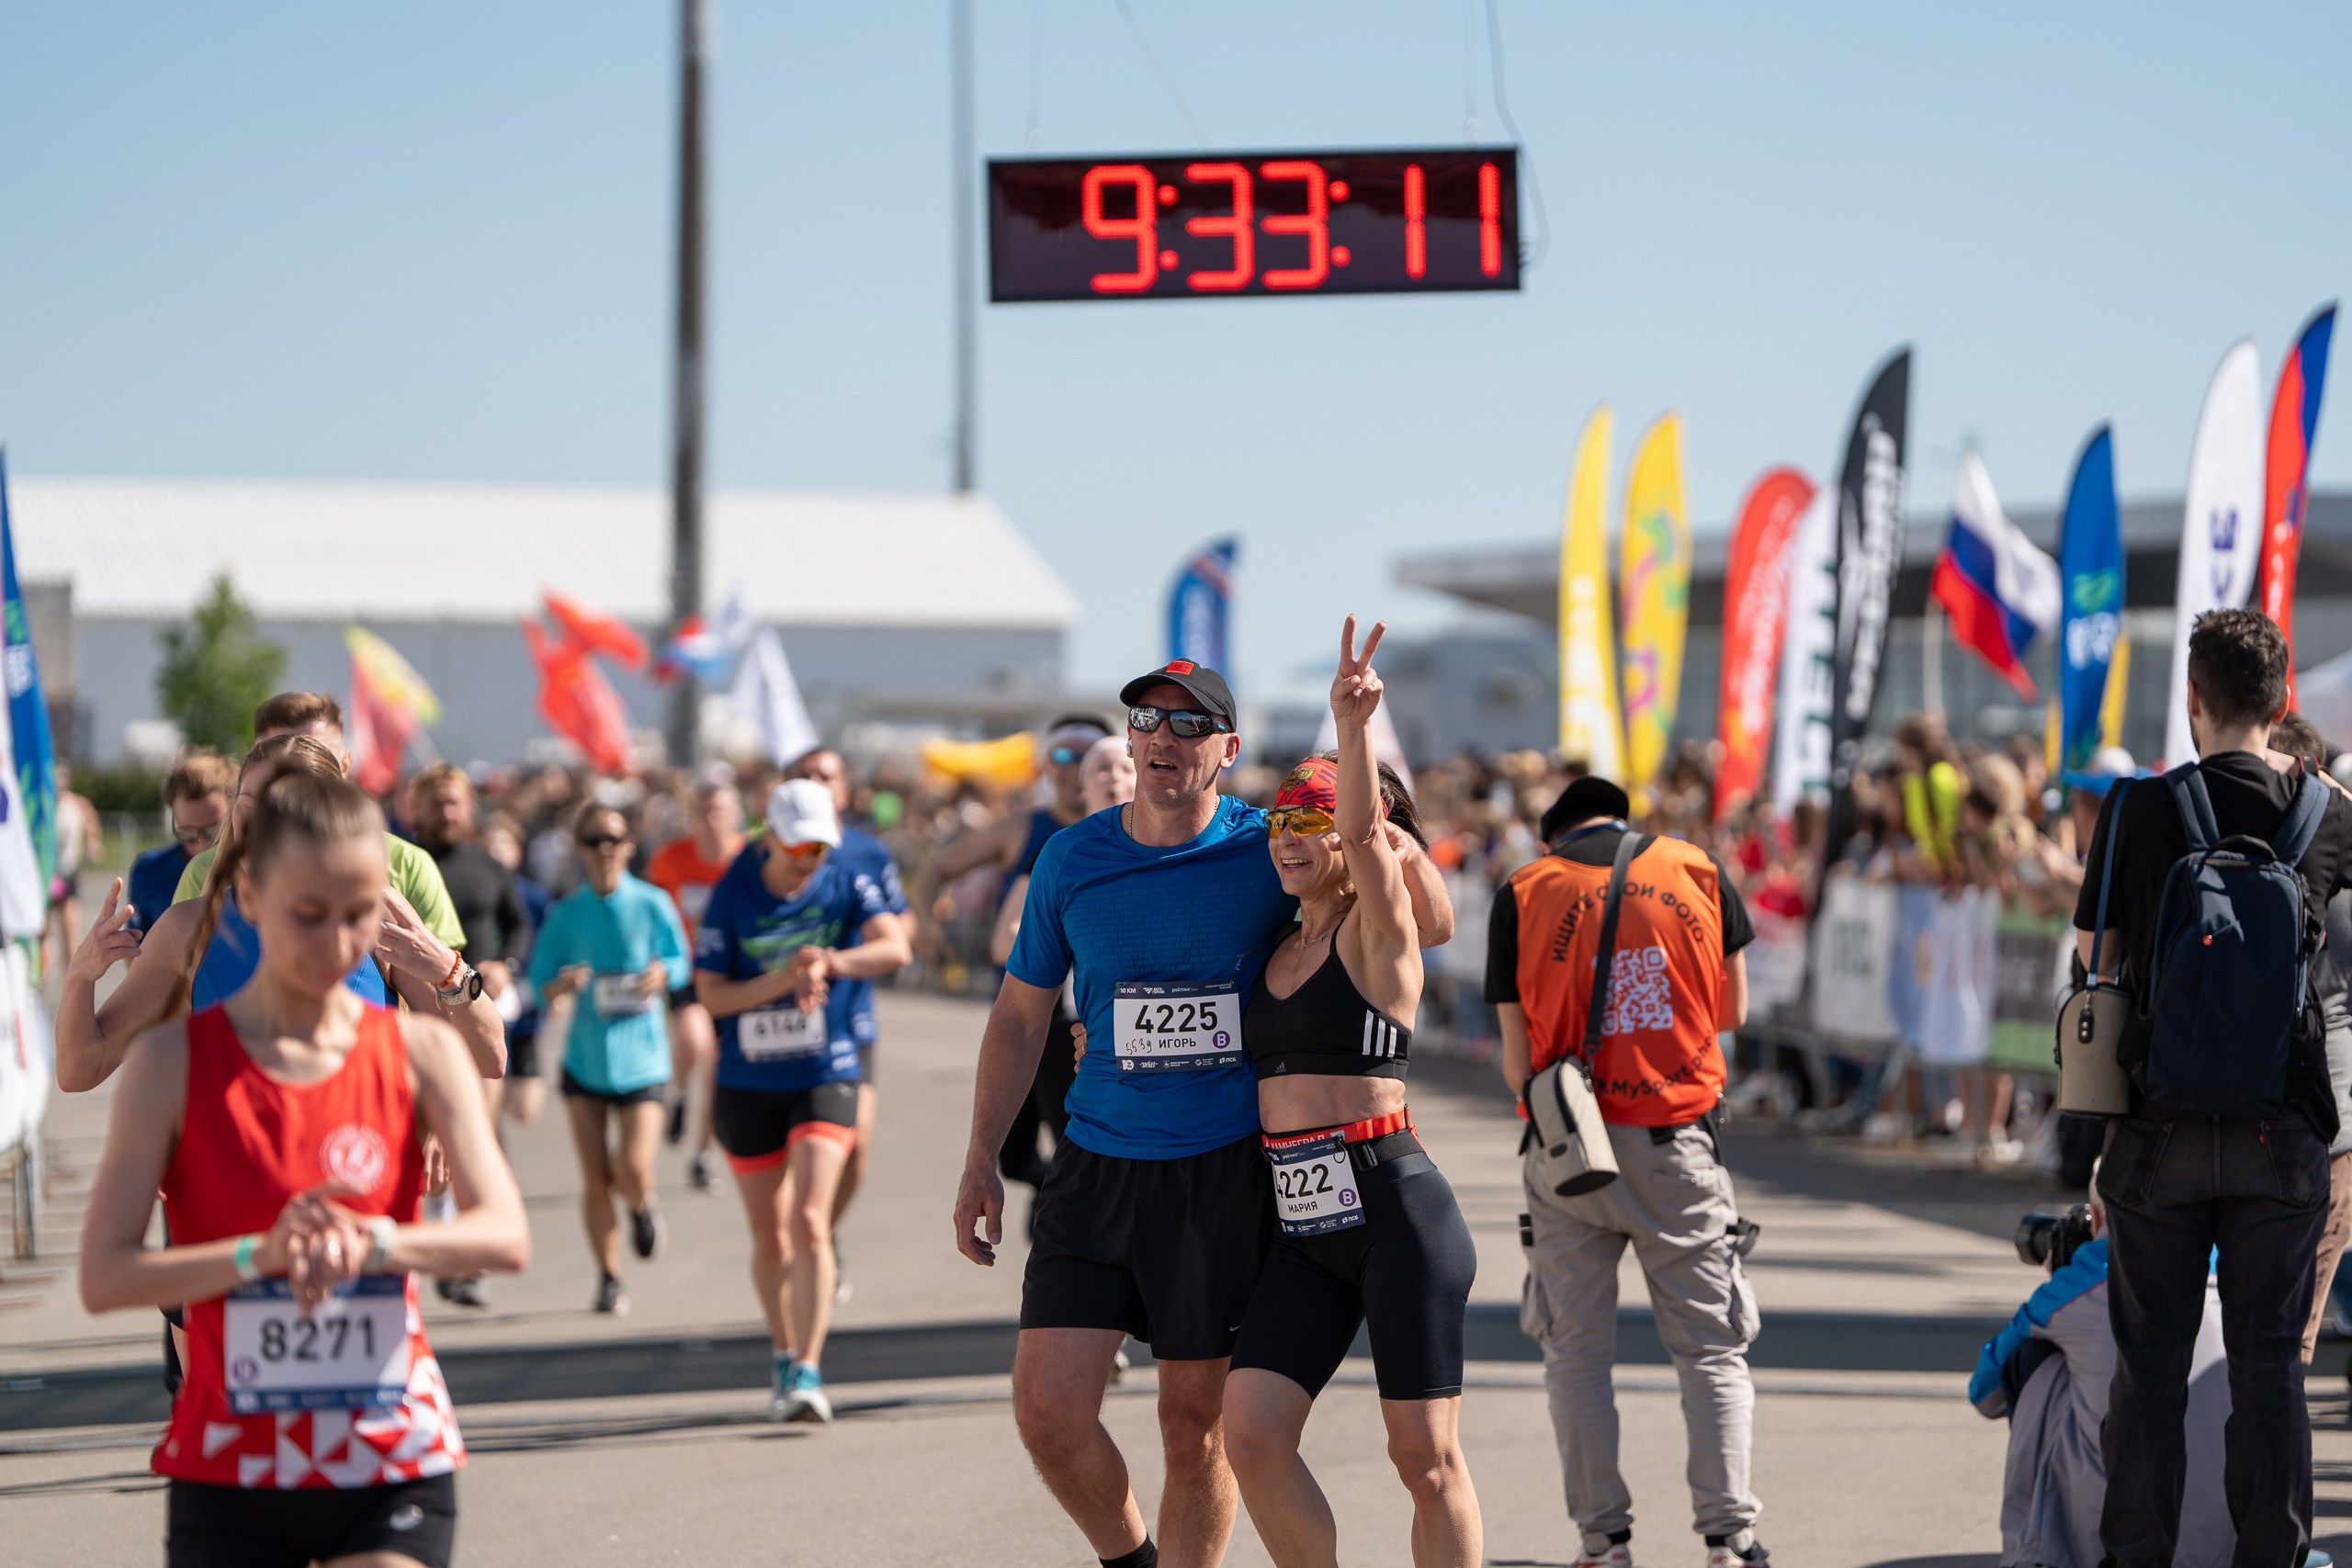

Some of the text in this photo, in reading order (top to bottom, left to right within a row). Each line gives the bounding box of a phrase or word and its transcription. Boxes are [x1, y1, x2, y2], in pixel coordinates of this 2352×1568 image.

[1081, 161, 1502, 293] 9:33:11
[1552, 882, 1704, 962] ИЩИТЕ СОИ ФОТО
[1135, 1001, 1218, 1034] 4225
[1159, 1038, 1197, 1048] ИГОРЬ
[1274, 1164, 1334, 1199] 4222
[1288, 1201, 1318, 1213] МАРИЯ
[259, 1315, 376, 1363] 8271
